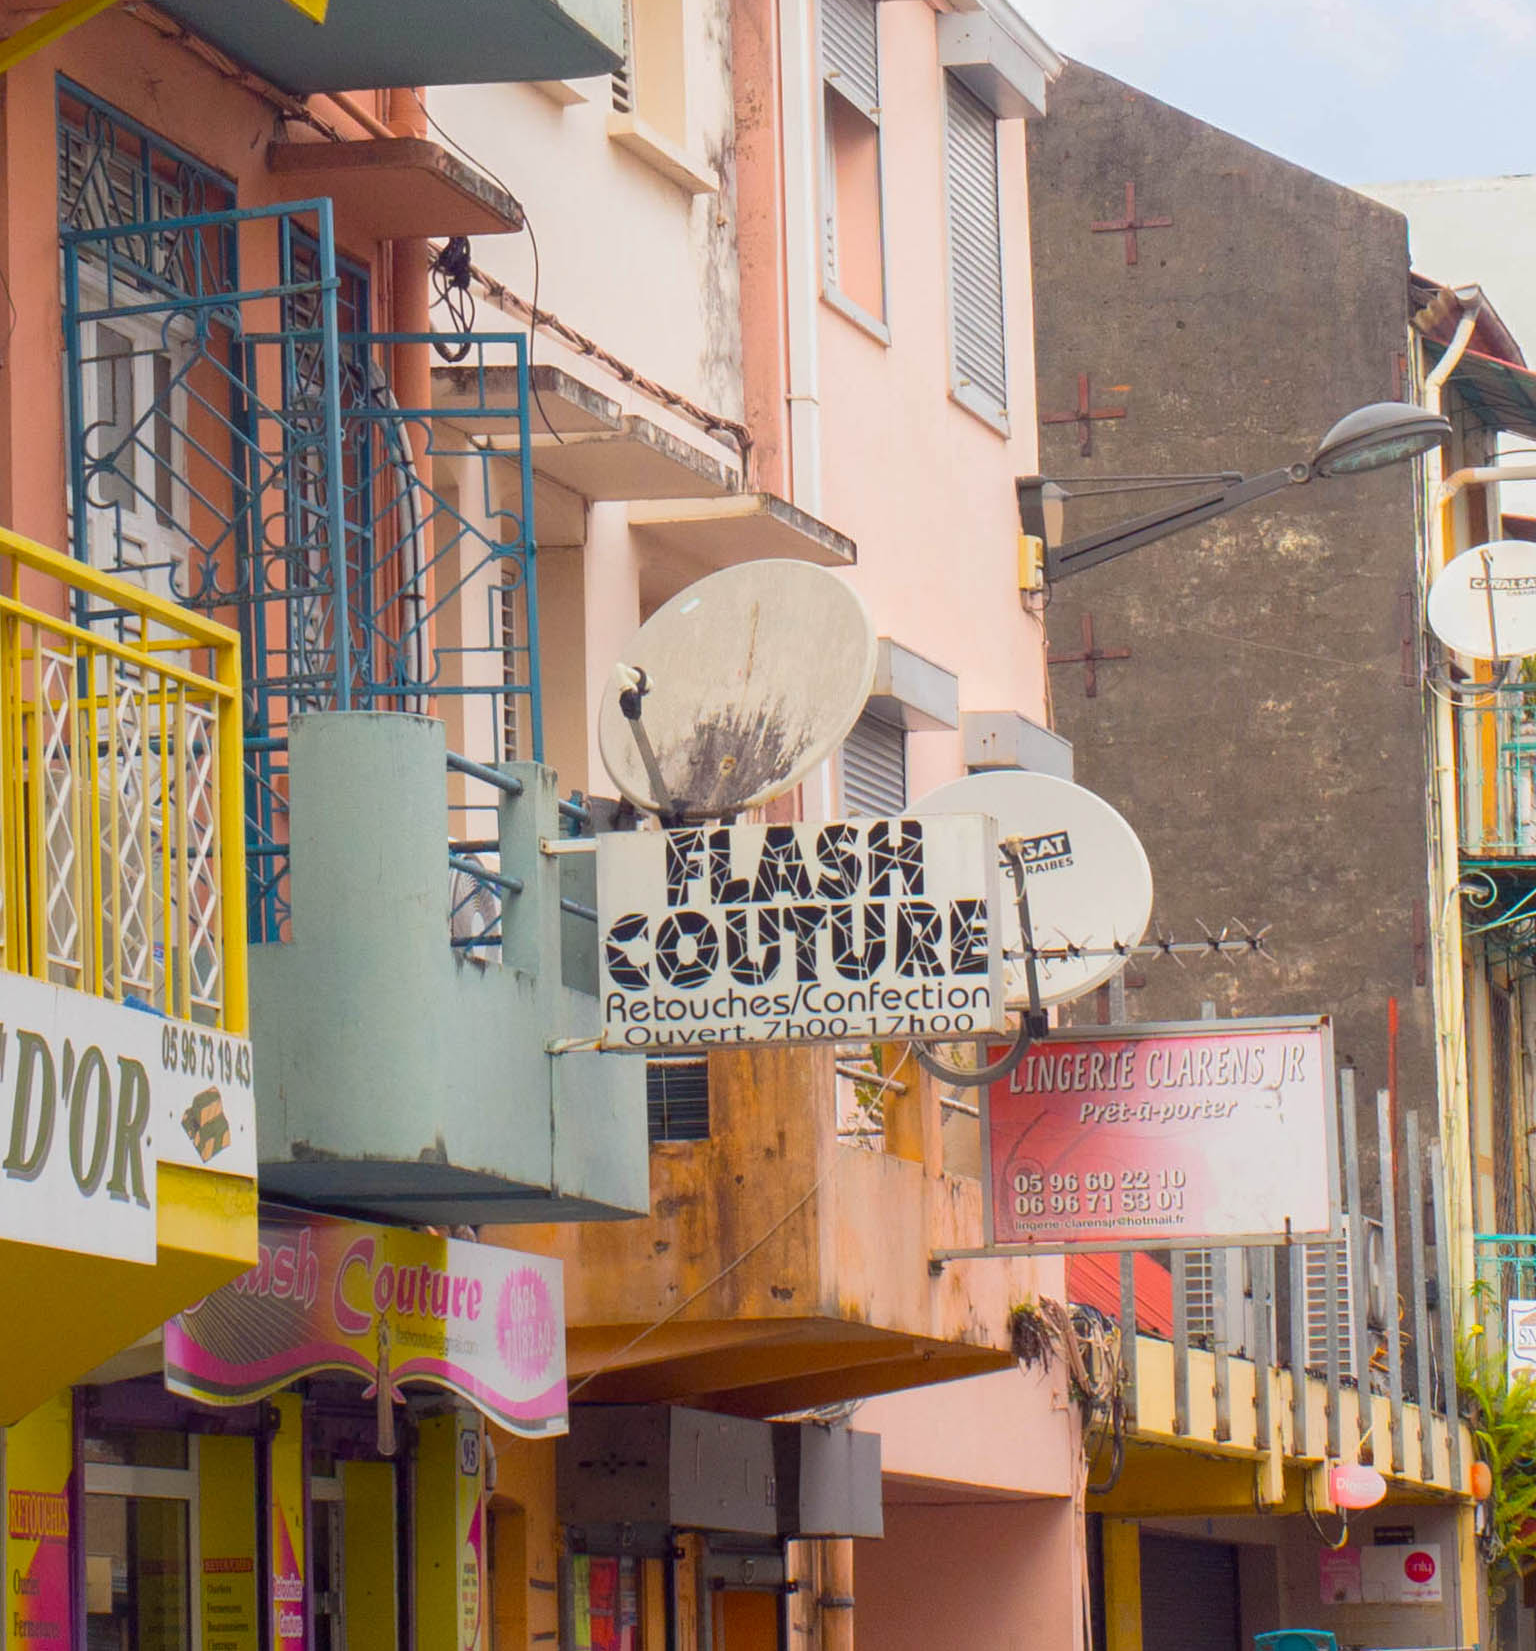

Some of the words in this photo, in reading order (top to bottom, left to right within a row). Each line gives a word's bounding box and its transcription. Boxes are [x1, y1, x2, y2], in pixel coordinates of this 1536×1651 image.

[666, 820, 925, 907] FLASH
[1005, 857, 1074, 878] CRAIBES
[605, 899, 989, 990] COUTURE
[606, 981, 991, 1024] Retouches/Confection
[765, 1012, 974, 1040] 7h00-17h00
[162, 1024, 178, 1071] 05
[181, 1028, 197, 1076] 96
[199, 1033, 215, 1081] 73
[218, 1038, 232, 1086] 19
[235, 1044, 251, 1090] 43
[1010, 1050, 1136, 1094] LINGERIE
[1145, 1044, 1265, 1088] CLARENS
[1274, 1043, 1305, 1089] JR
[2, 1028, 152, 1209] D'OR
[1014, 1174, 1044, 1194] 05
[1049, 1172, 1080, 1193] 96
[1085, 1171, 1115, 1193] 60
[1120, 1169, 1151, 1191] 22
[1157, 1168, 1187, 1189] 10
[1014, 1195, 1045, 1216] 06
[1049, 1194, 1080, 1215] 96
[1086, 1193, 1113, 1214] 71
[1121, 1192, 1151, 1213] 83
[1157, 1191, 1185, 1212] 01
[332, 1235, 483, 1335] Couture
